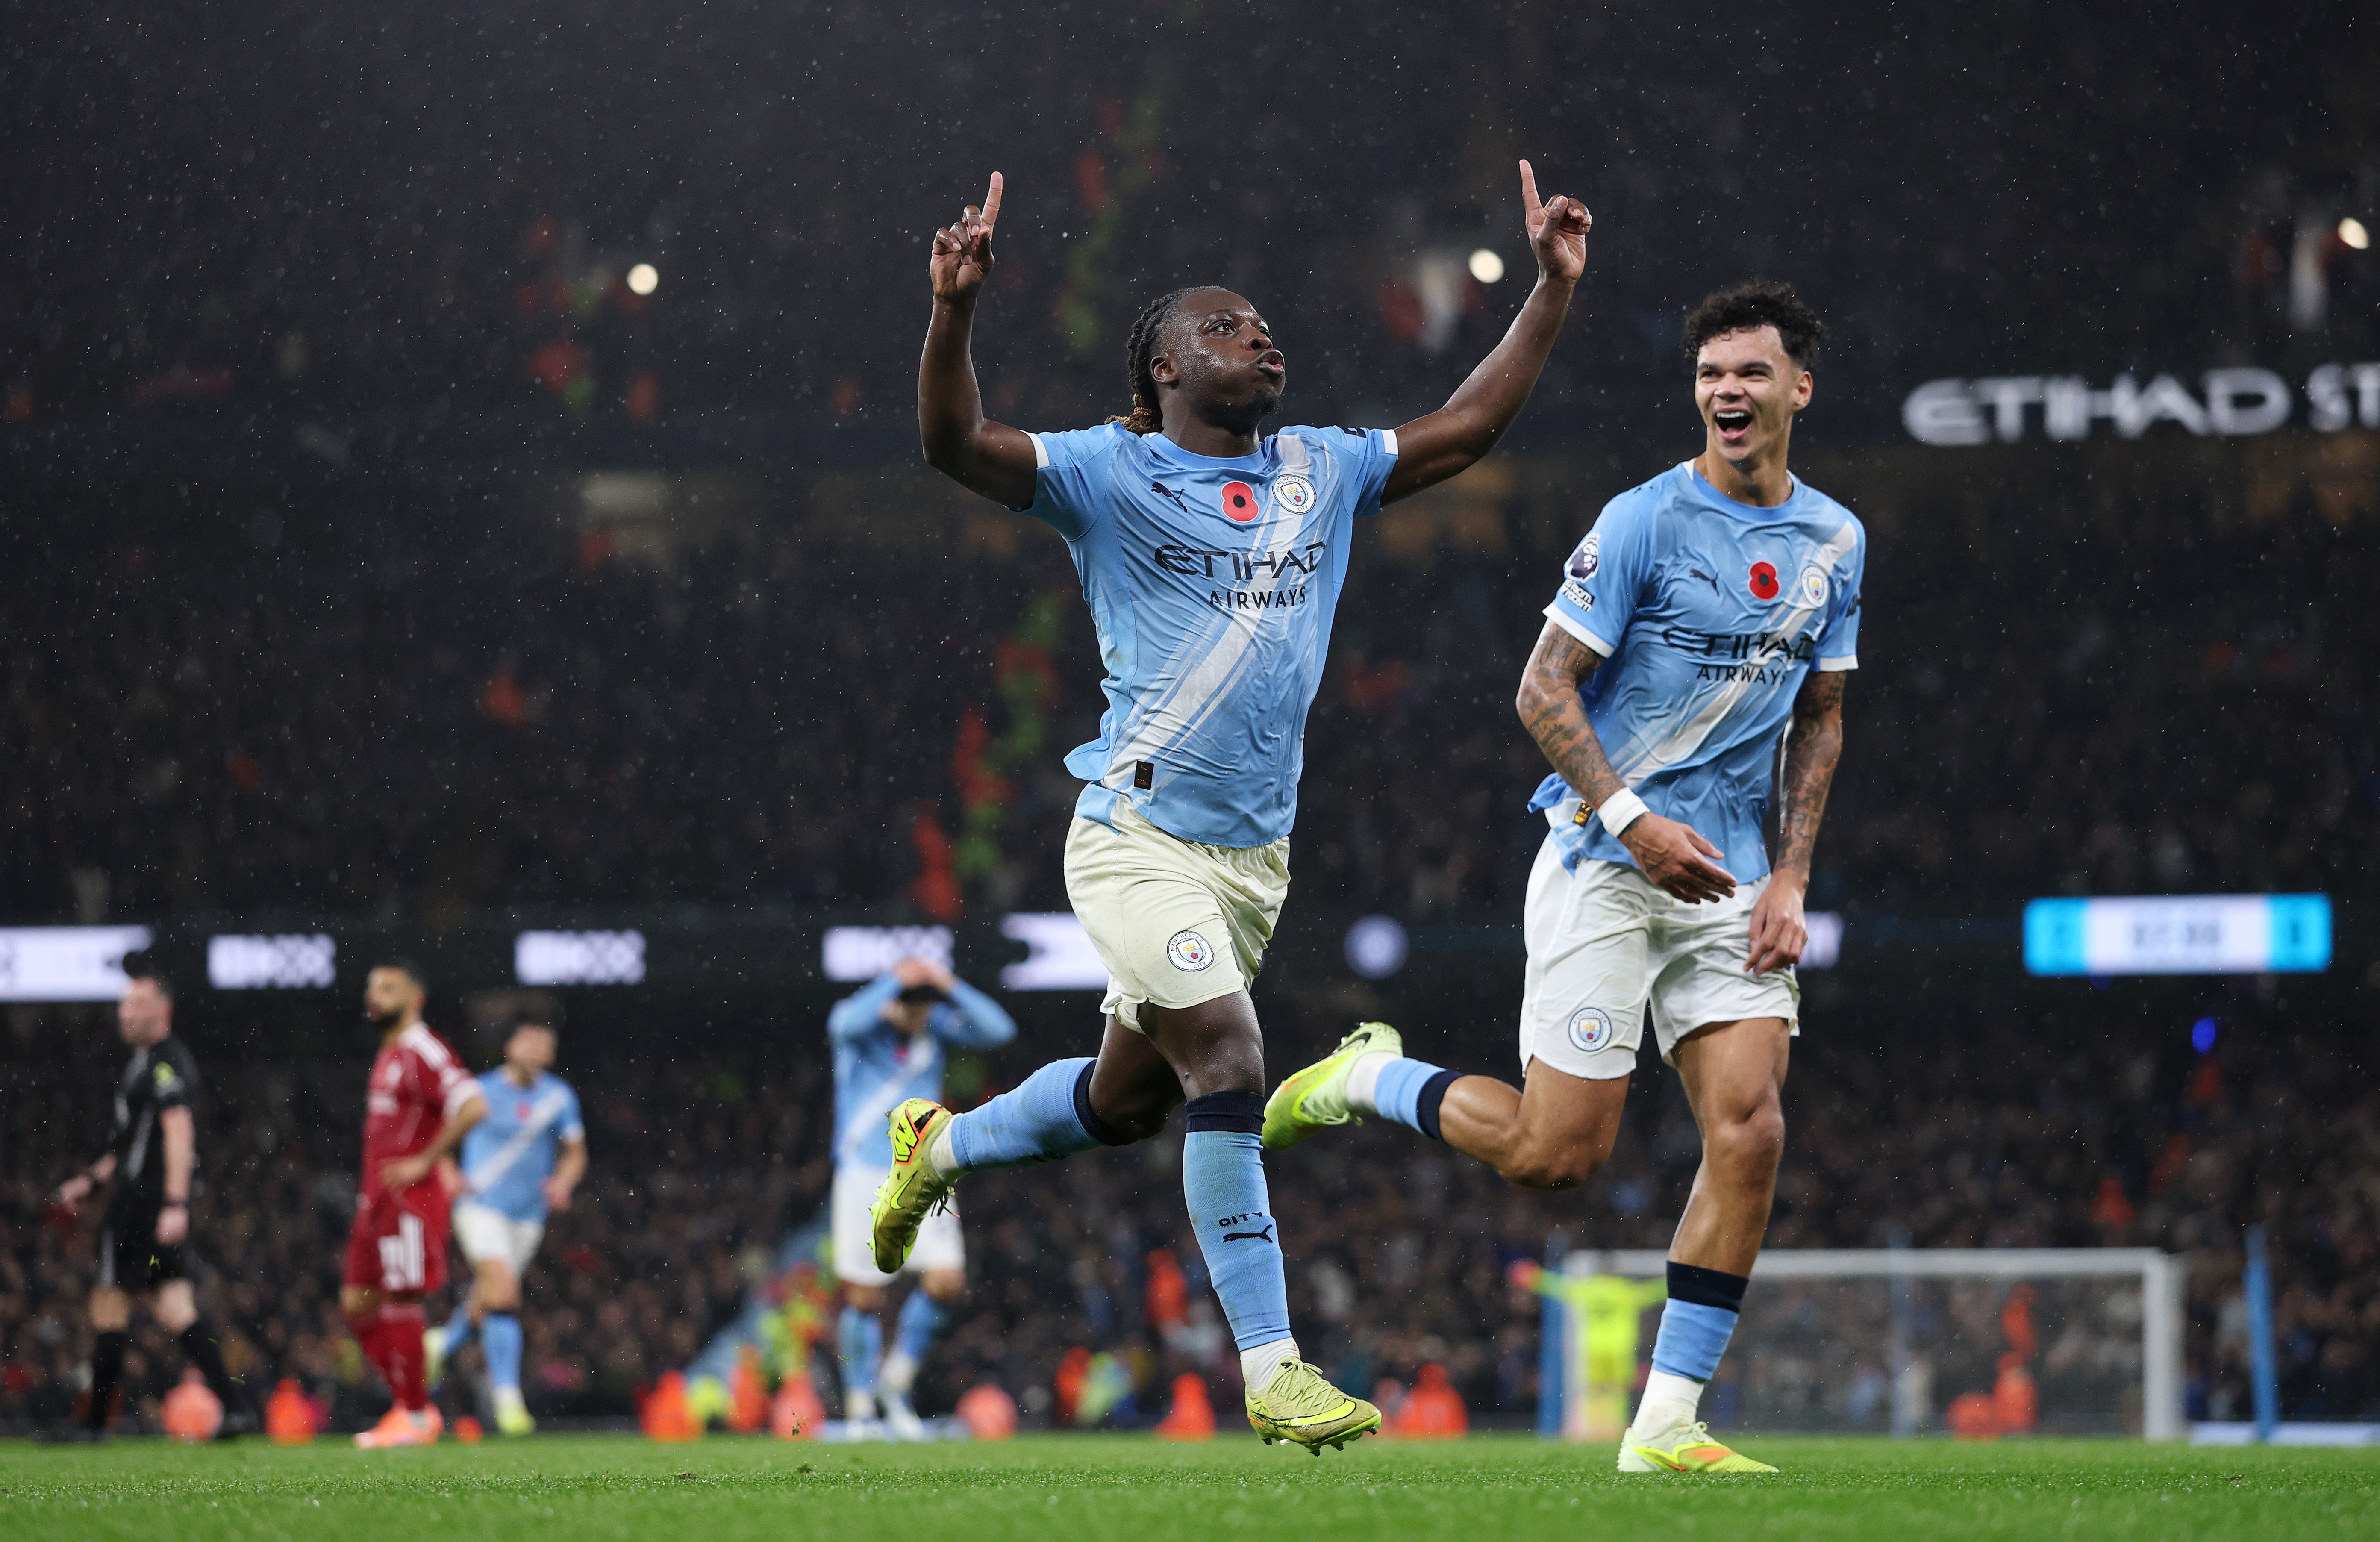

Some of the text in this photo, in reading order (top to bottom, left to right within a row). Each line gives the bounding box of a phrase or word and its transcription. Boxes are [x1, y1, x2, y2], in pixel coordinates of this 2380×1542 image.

[1902, 368, 2291, 446] ETIHAD
[1276, 477, 1305, 492] MANCHESTER
[1210, 586, 1306, 609] AIRWAYS
[1171, 933, 1203, 951] MANCHESTER
